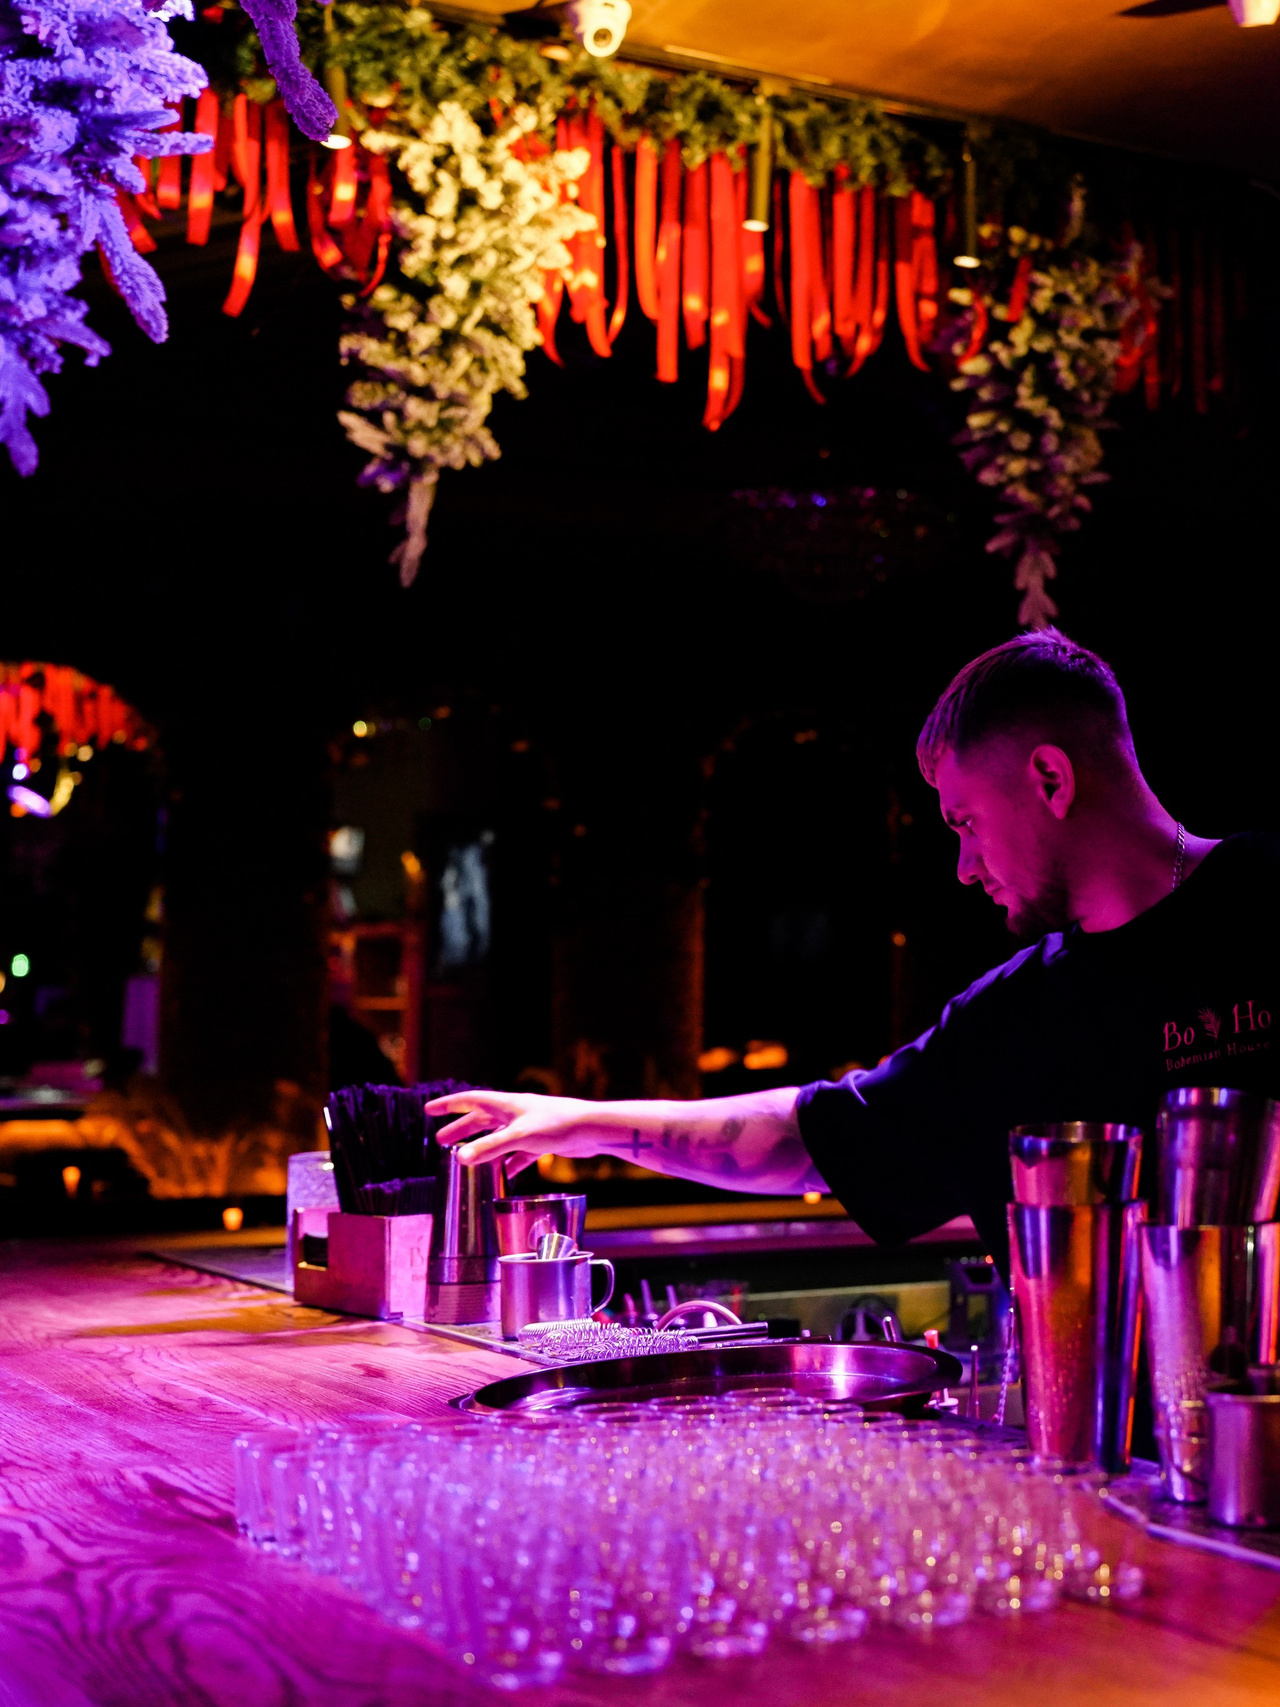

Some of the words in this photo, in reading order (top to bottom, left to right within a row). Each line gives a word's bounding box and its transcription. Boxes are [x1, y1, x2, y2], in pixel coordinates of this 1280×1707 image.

[1162, 1021, 1196, 1052] Bo
[1232, 1000, 1271, 1034] Ho
[1165, 1049, 1221, 1072] Bohemian
[1226, 1041, 1270, 1056] House
